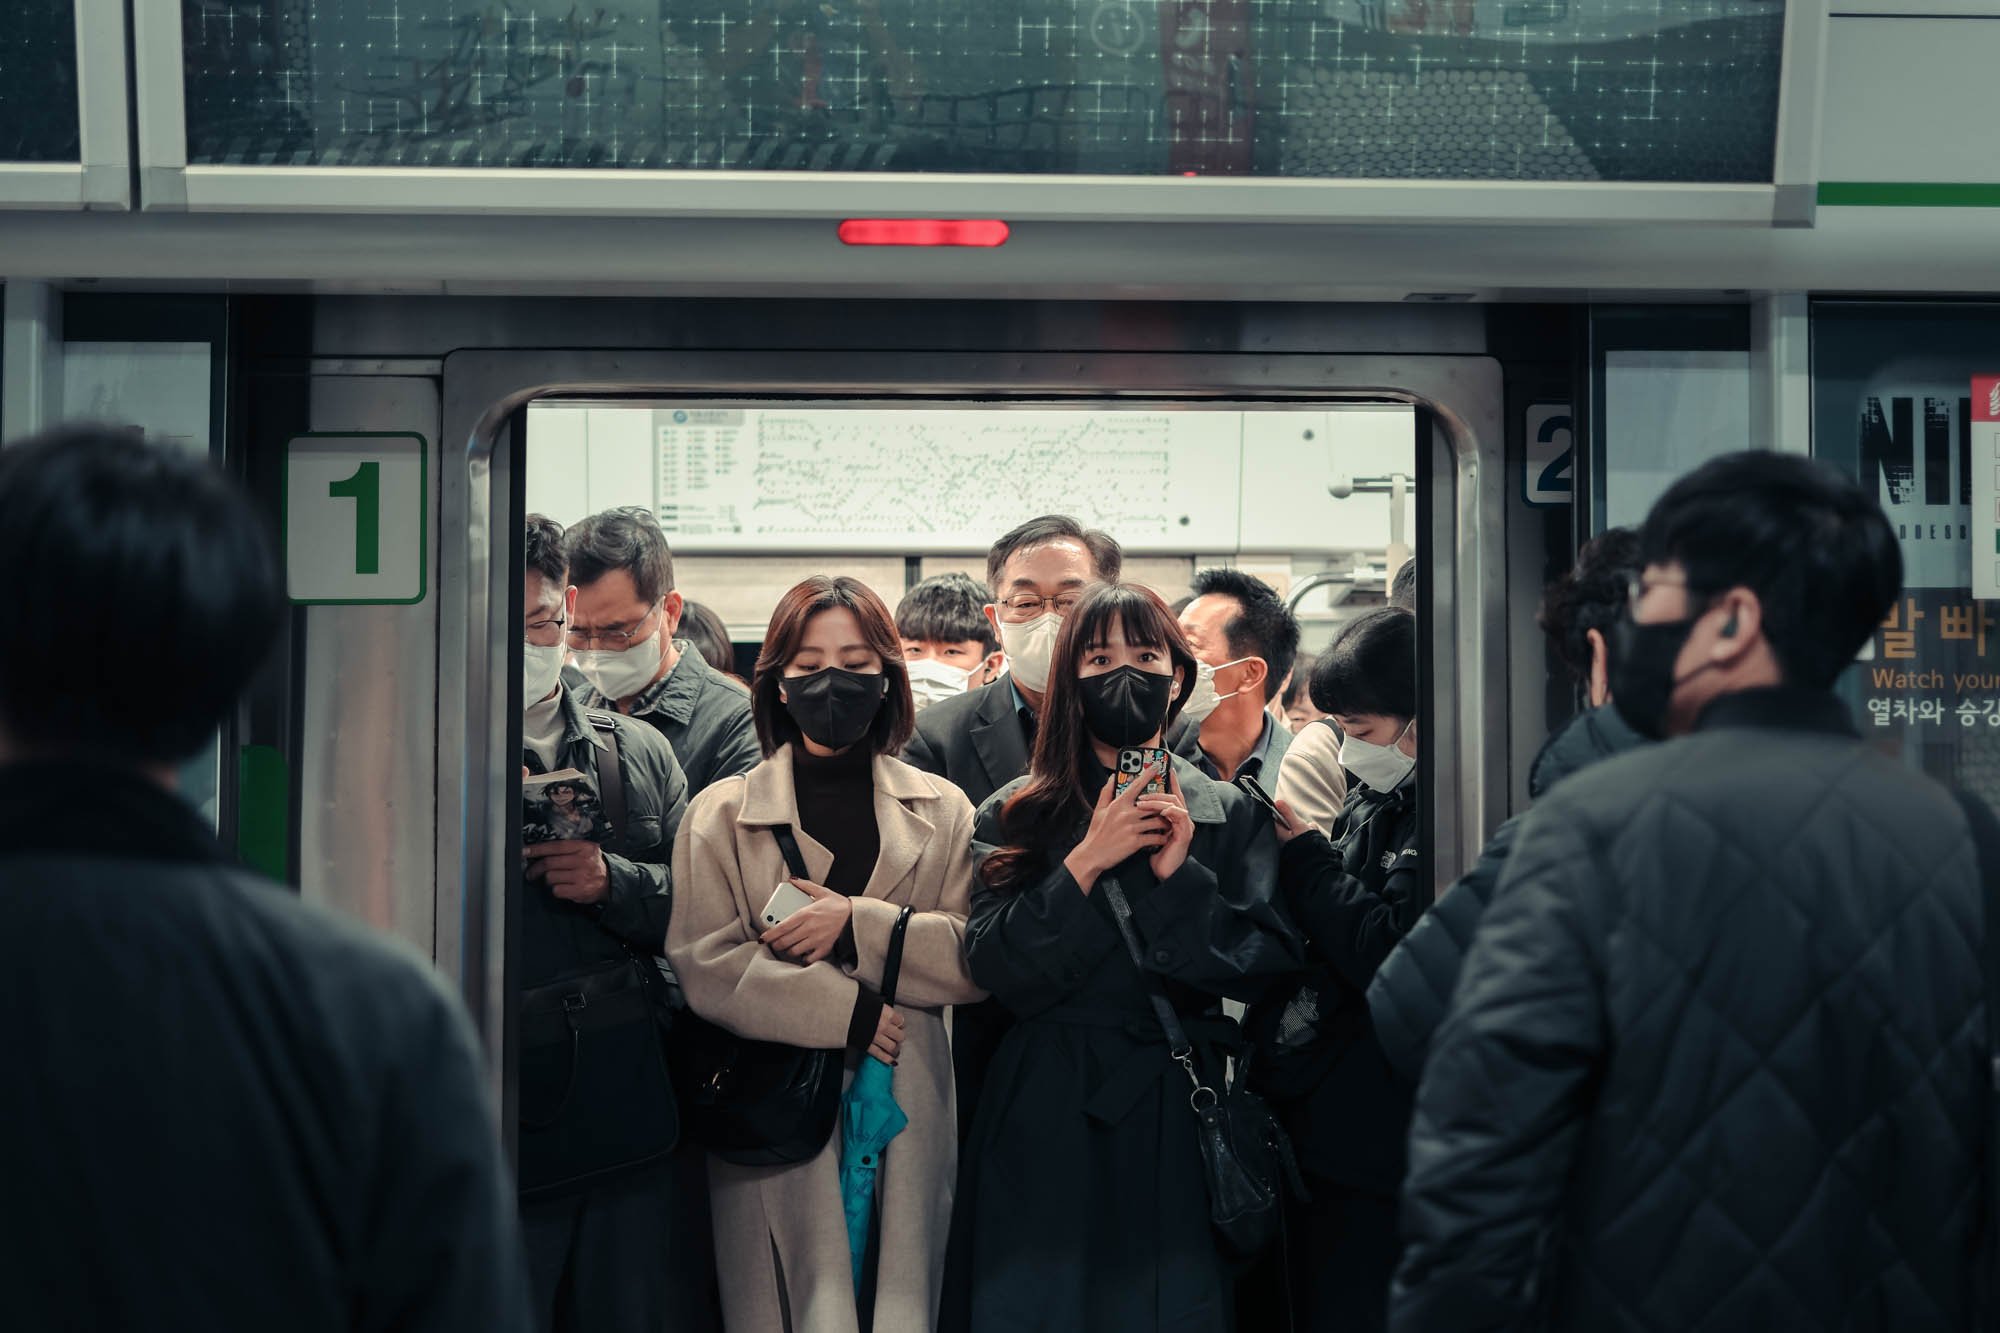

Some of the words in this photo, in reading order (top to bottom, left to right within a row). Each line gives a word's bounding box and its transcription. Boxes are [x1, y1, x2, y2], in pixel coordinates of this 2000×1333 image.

[1537, 415, 1573, 491] 2
[1859, 397, 1971, 505] NI
[329, 462, 380, 574] 1
[1867, 697, 1945, 727] 열차와
[1872, 667, 1944, 689] Watch
